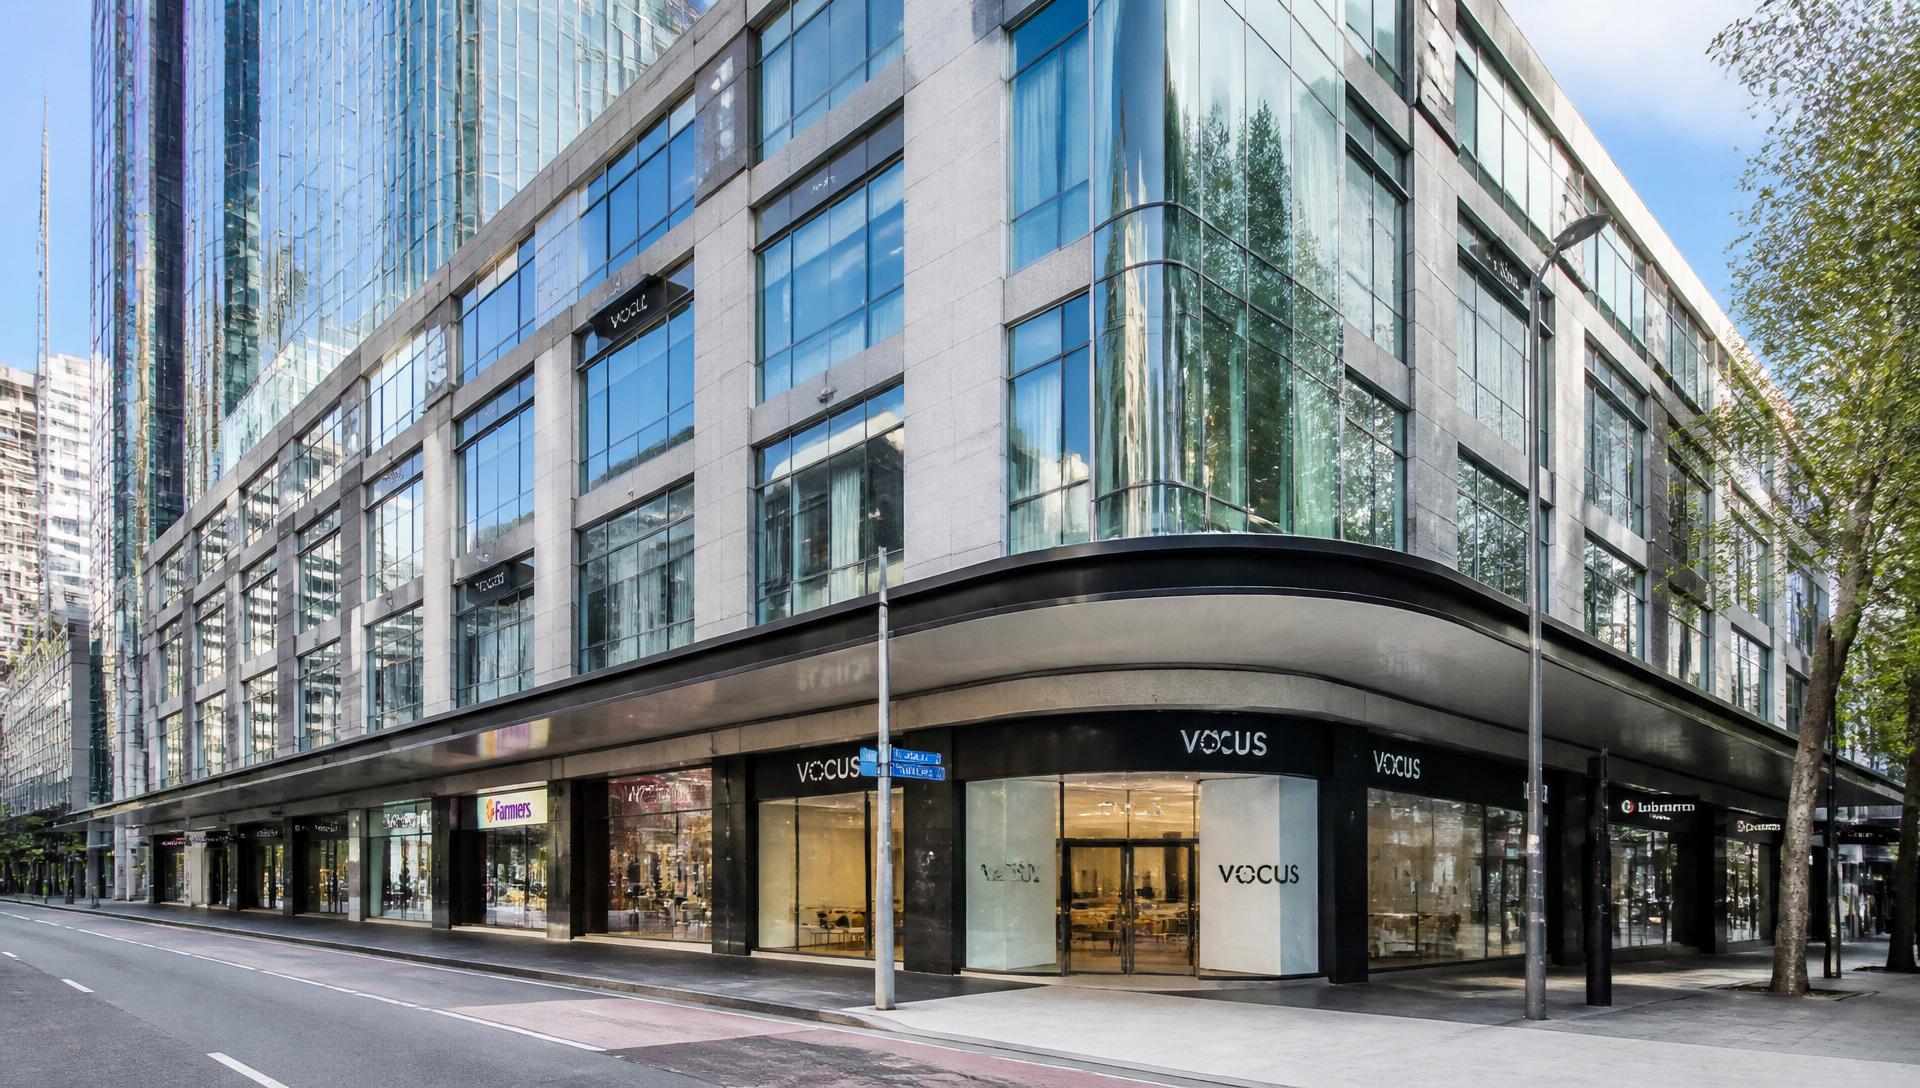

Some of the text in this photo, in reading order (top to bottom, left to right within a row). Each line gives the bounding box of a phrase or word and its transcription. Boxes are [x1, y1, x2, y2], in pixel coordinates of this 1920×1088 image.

[1180, 729, 1268, 756] VOCUS
[796, 756, 860, 783] VOCUS
[1373, 750, 1421, 779] VOCUS
[1218, 864, 1300, 885] VOCUS
